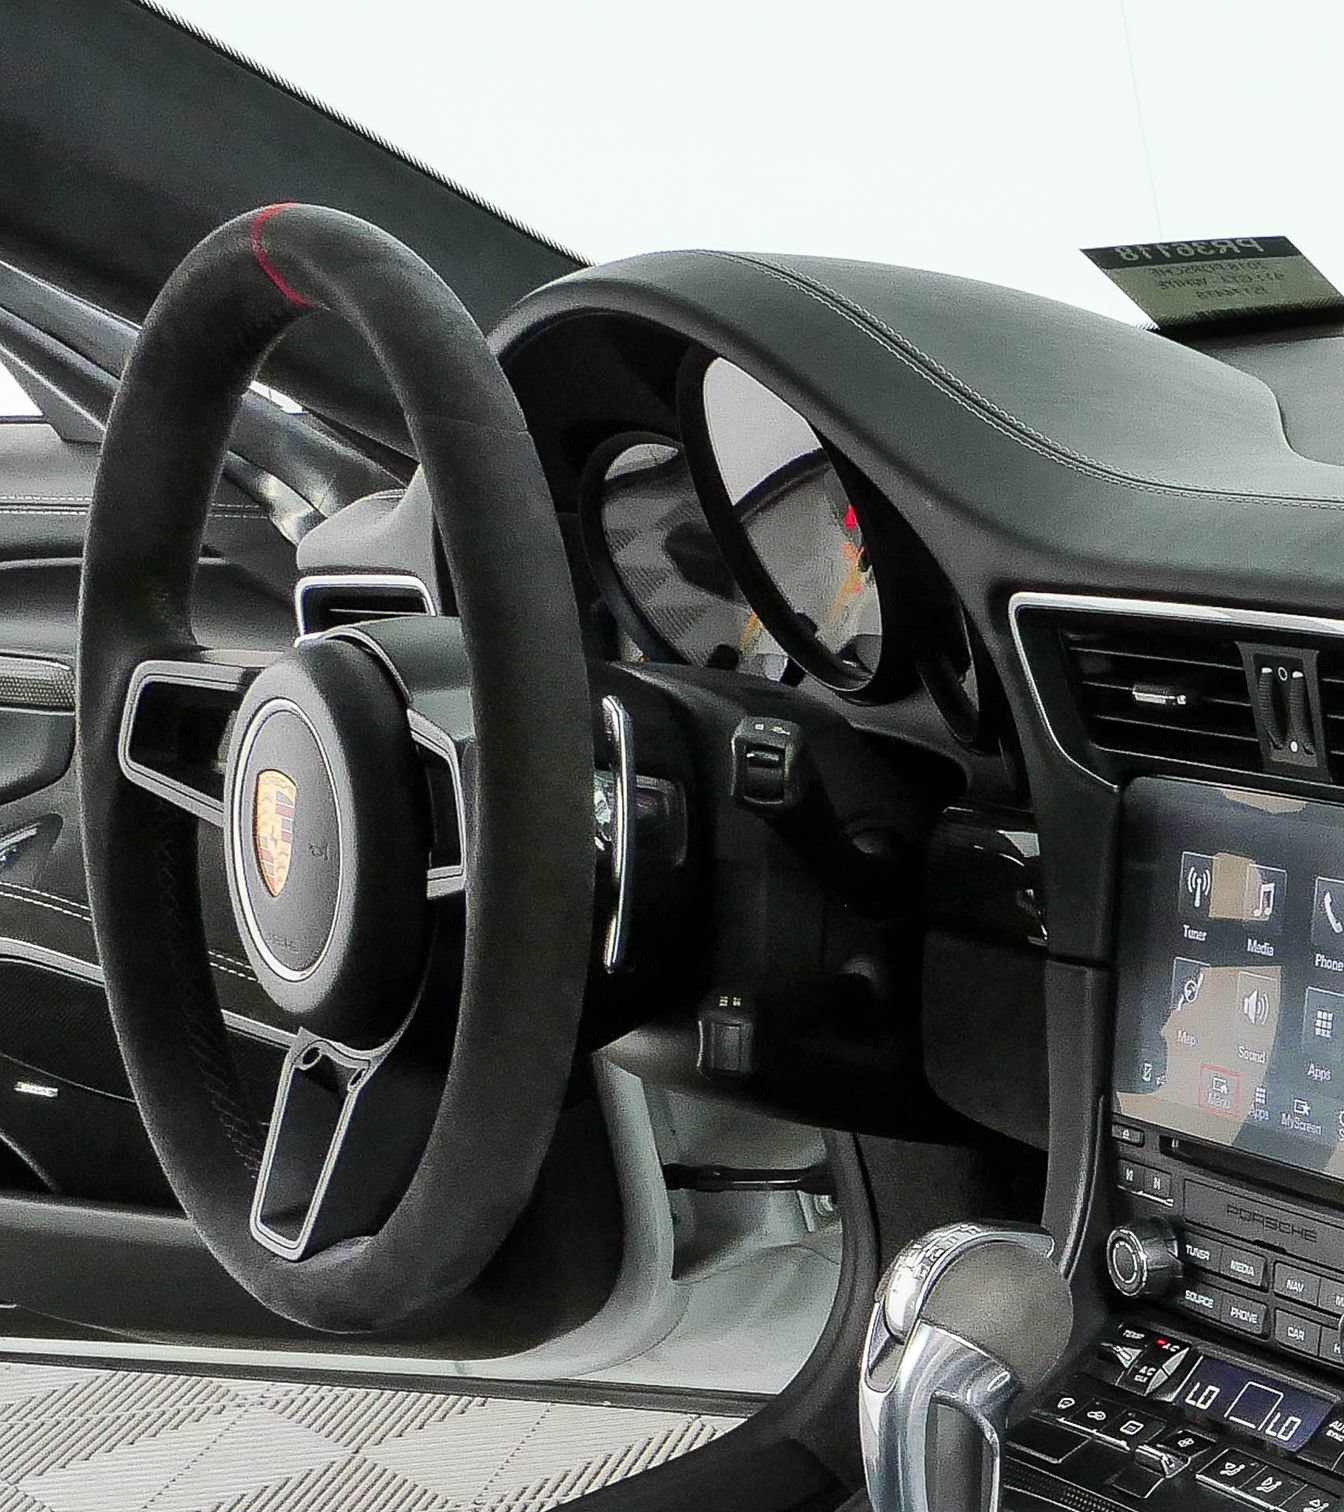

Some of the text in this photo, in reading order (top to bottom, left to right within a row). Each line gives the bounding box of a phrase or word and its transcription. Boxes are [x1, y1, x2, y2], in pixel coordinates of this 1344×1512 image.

[1183, 924, 1207, 941] Tuner
[1247, 938, 1274, 956] Media
[1315, 953, 1344, 972] Phone
[1177, 1030, 1197, 1047] Map
[1238, 1045, 1266, 1064] Sound
[1307, 1063, 1332, 1082] Apps
[1207, 1092, 1231, 1110] Menu
[1281, 1112, 1323, 1136] MyScreen
[1226, 1204, 1318, 1244] PORSCHE
[1185, 1244, 1210, 1260] TUNER
[1230, 1259, 1255, 1276] MEDIA
[1286, 1279, 1304, 1293] NAV
[1185, 1289, 1214, 1308] SOURCE
[1230, 1306, 1258, 1323] PHONE
[1287, 1326, 1305, 1341] CAR
[1185, 1382, 1220, 1410] LO
[1265, 1411, 1301, 1441] LO
